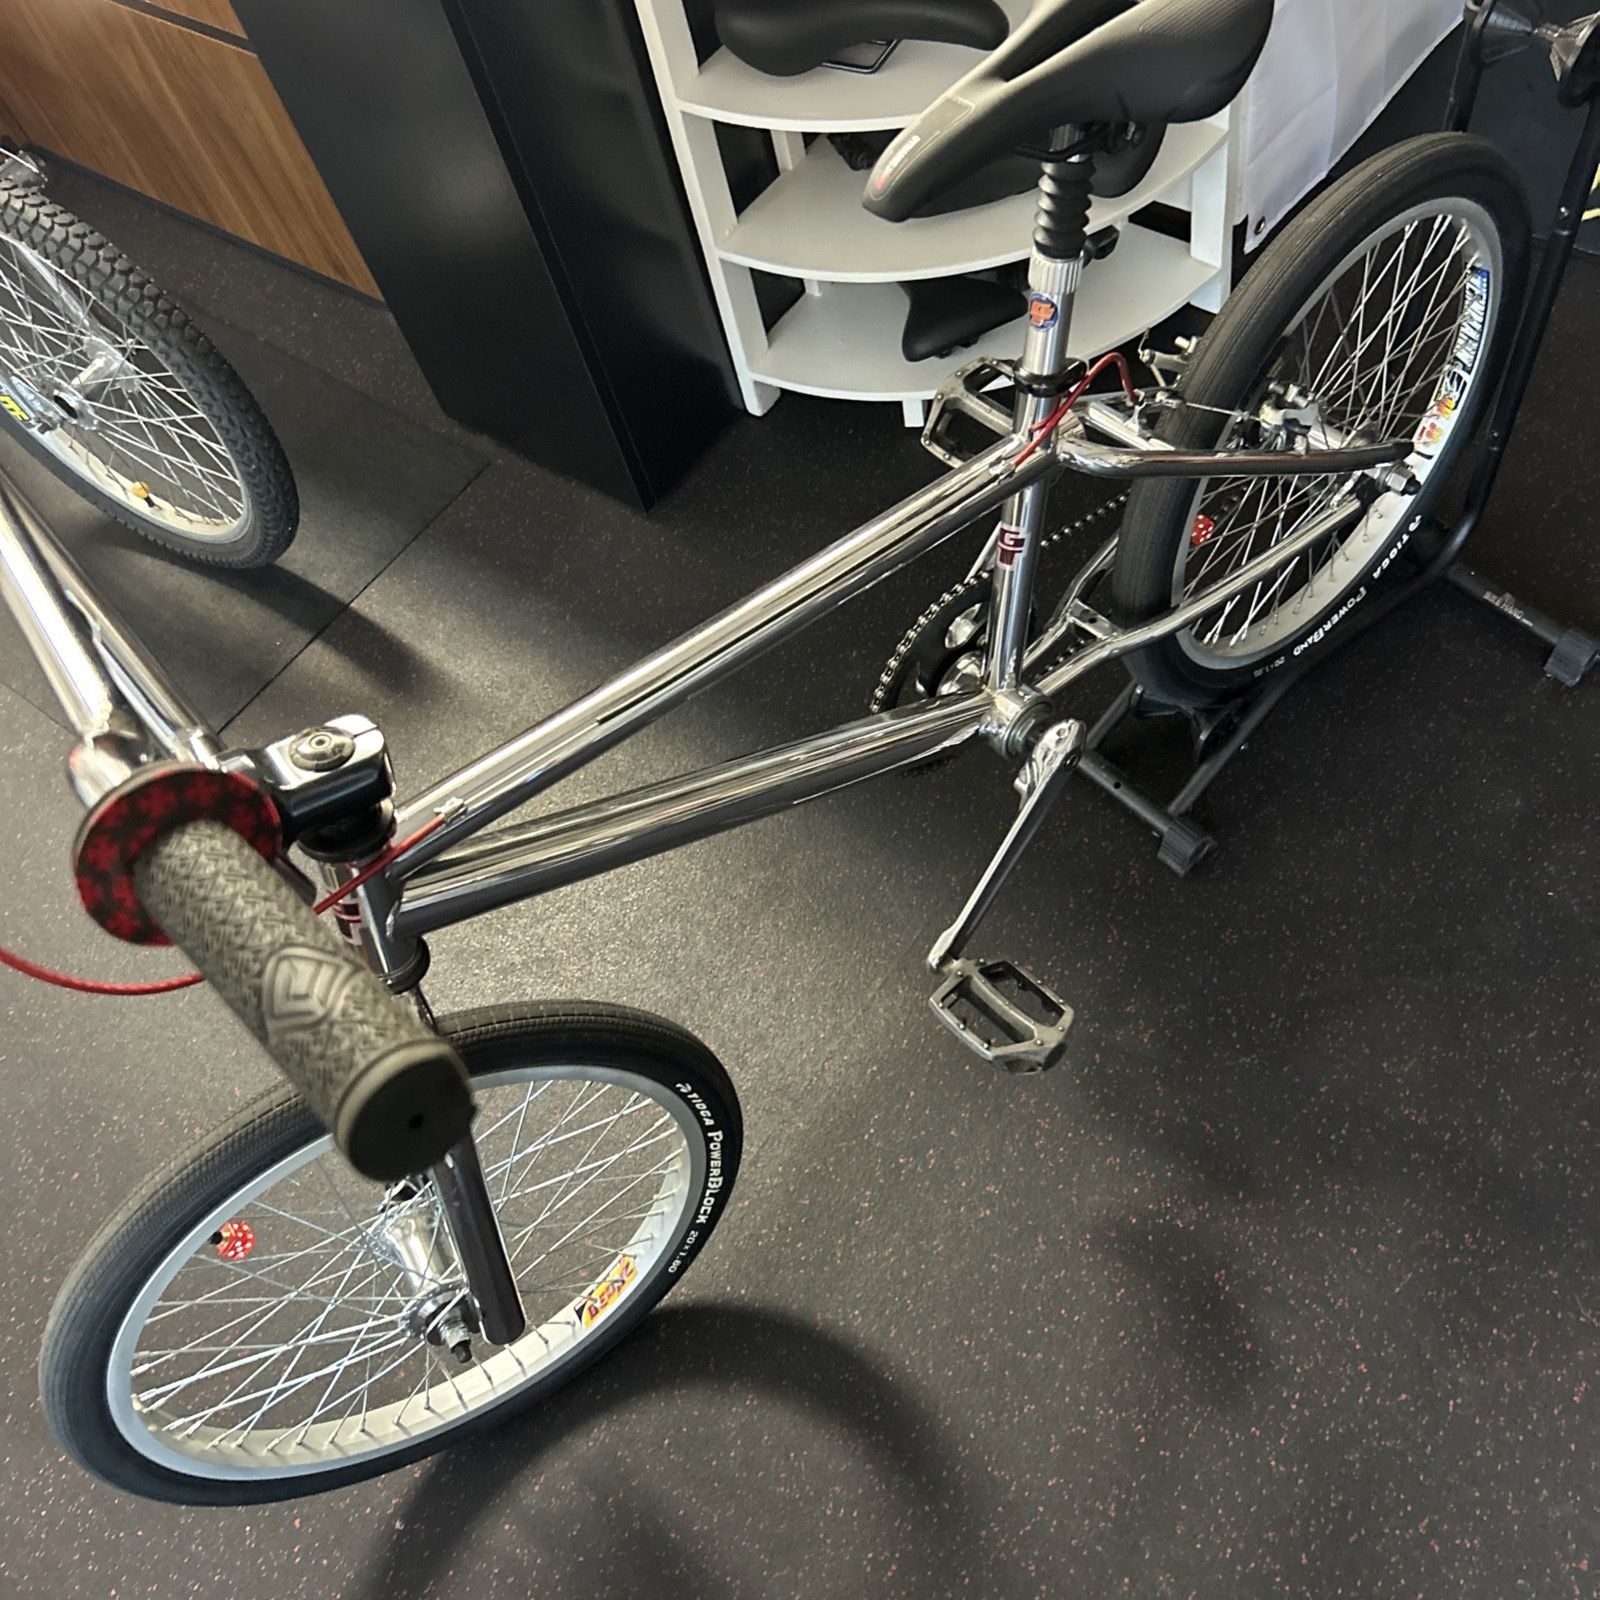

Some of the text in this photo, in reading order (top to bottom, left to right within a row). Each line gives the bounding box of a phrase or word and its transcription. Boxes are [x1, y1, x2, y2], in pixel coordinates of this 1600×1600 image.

[1000, 528, 1025, 565] GT
[1373, 534, 1409, 579] TIOGA
[1293, 586, 1366, 656] POWERBAND
[687, 1093, 715, 1126] TIOGA
[695, 1130, 723, 1224] POWERBLOCK
